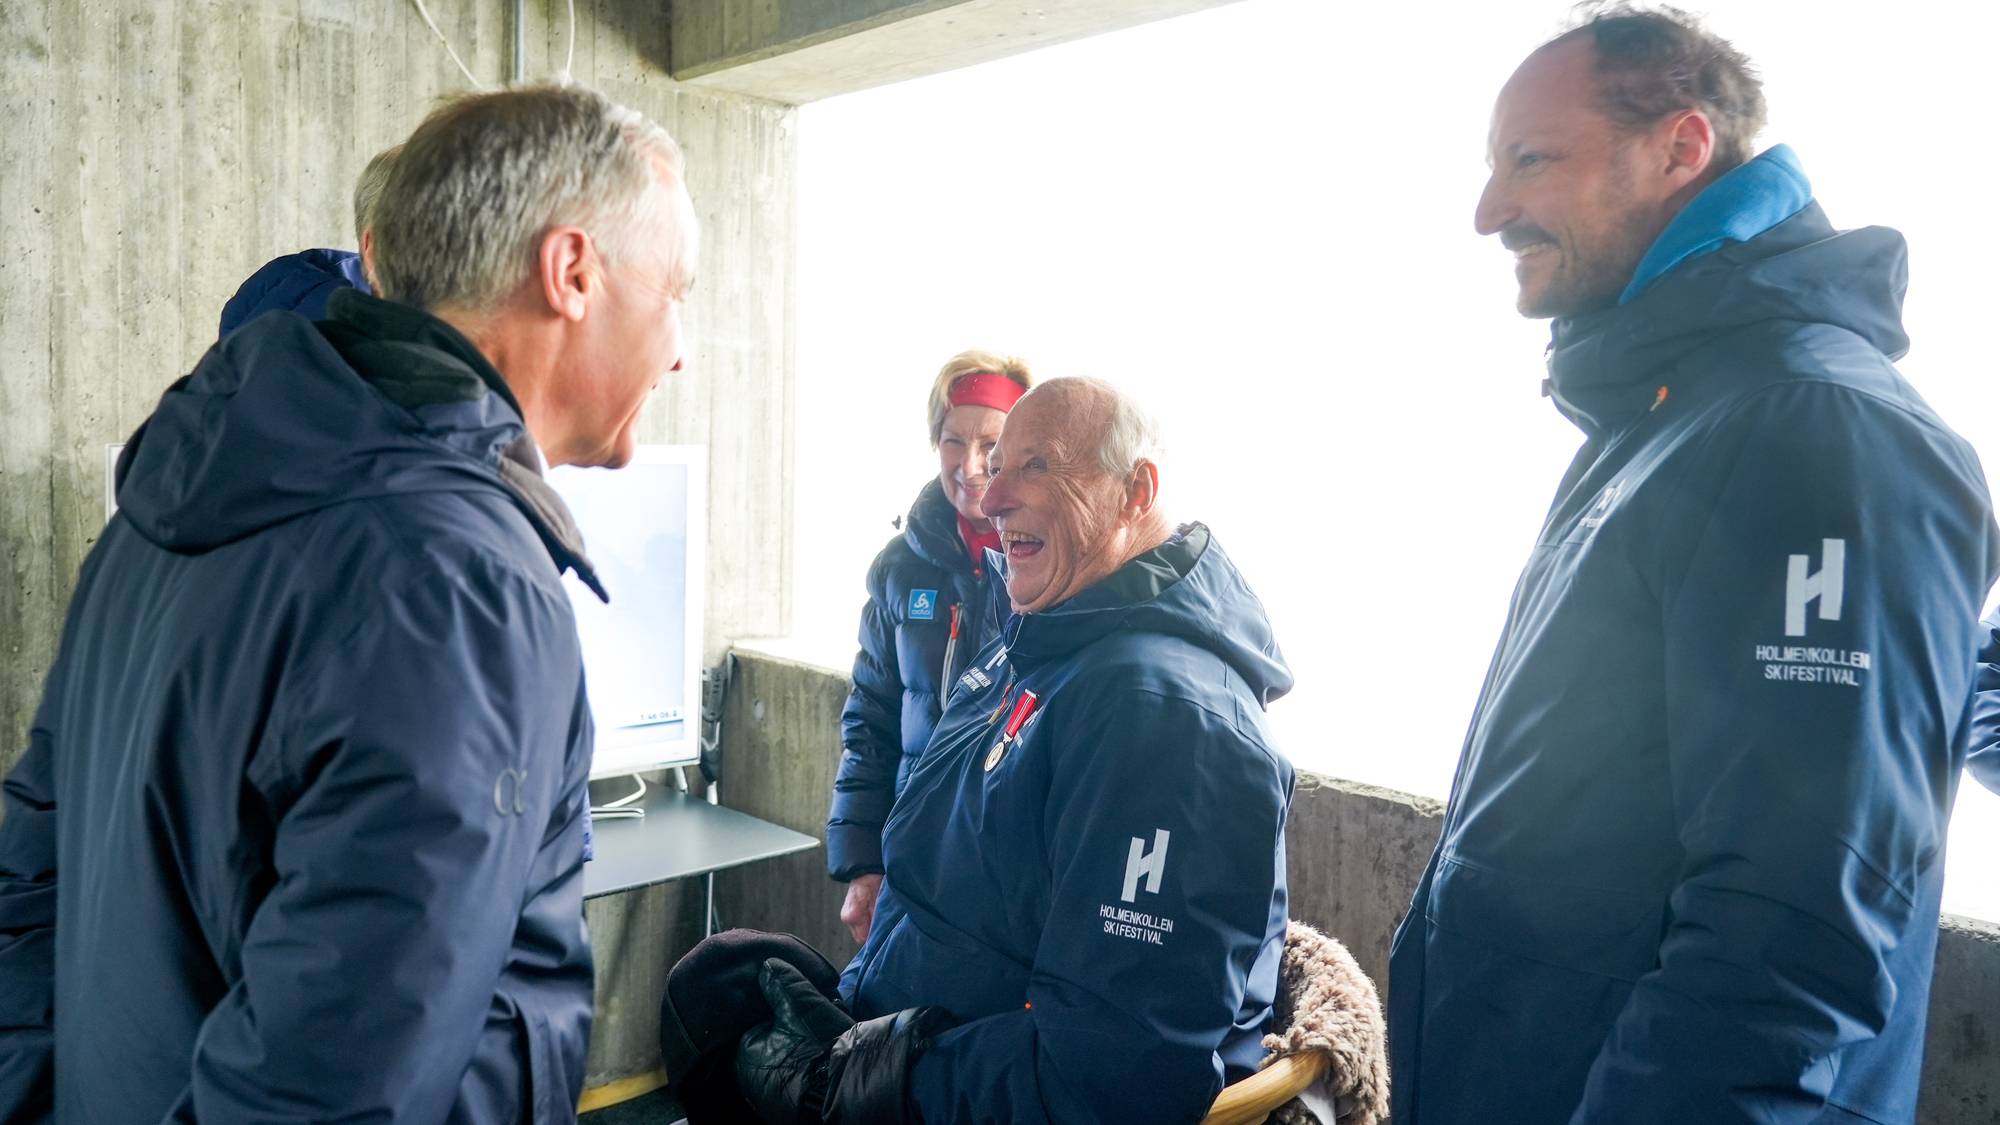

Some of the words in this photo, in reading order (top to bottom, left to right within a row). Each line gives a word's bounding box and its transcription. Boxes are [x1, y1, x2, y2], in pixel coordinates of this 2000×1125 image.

[1756, 645, 1871, 669] HOLMENKOLLEN
[1764, 664, 1859, 685] SKIFESTIVAL
[1100, 904, 1173, 932] HOLMENKOLLEN
[1103, 920, 1163, 945] SKIFESTIVAL
